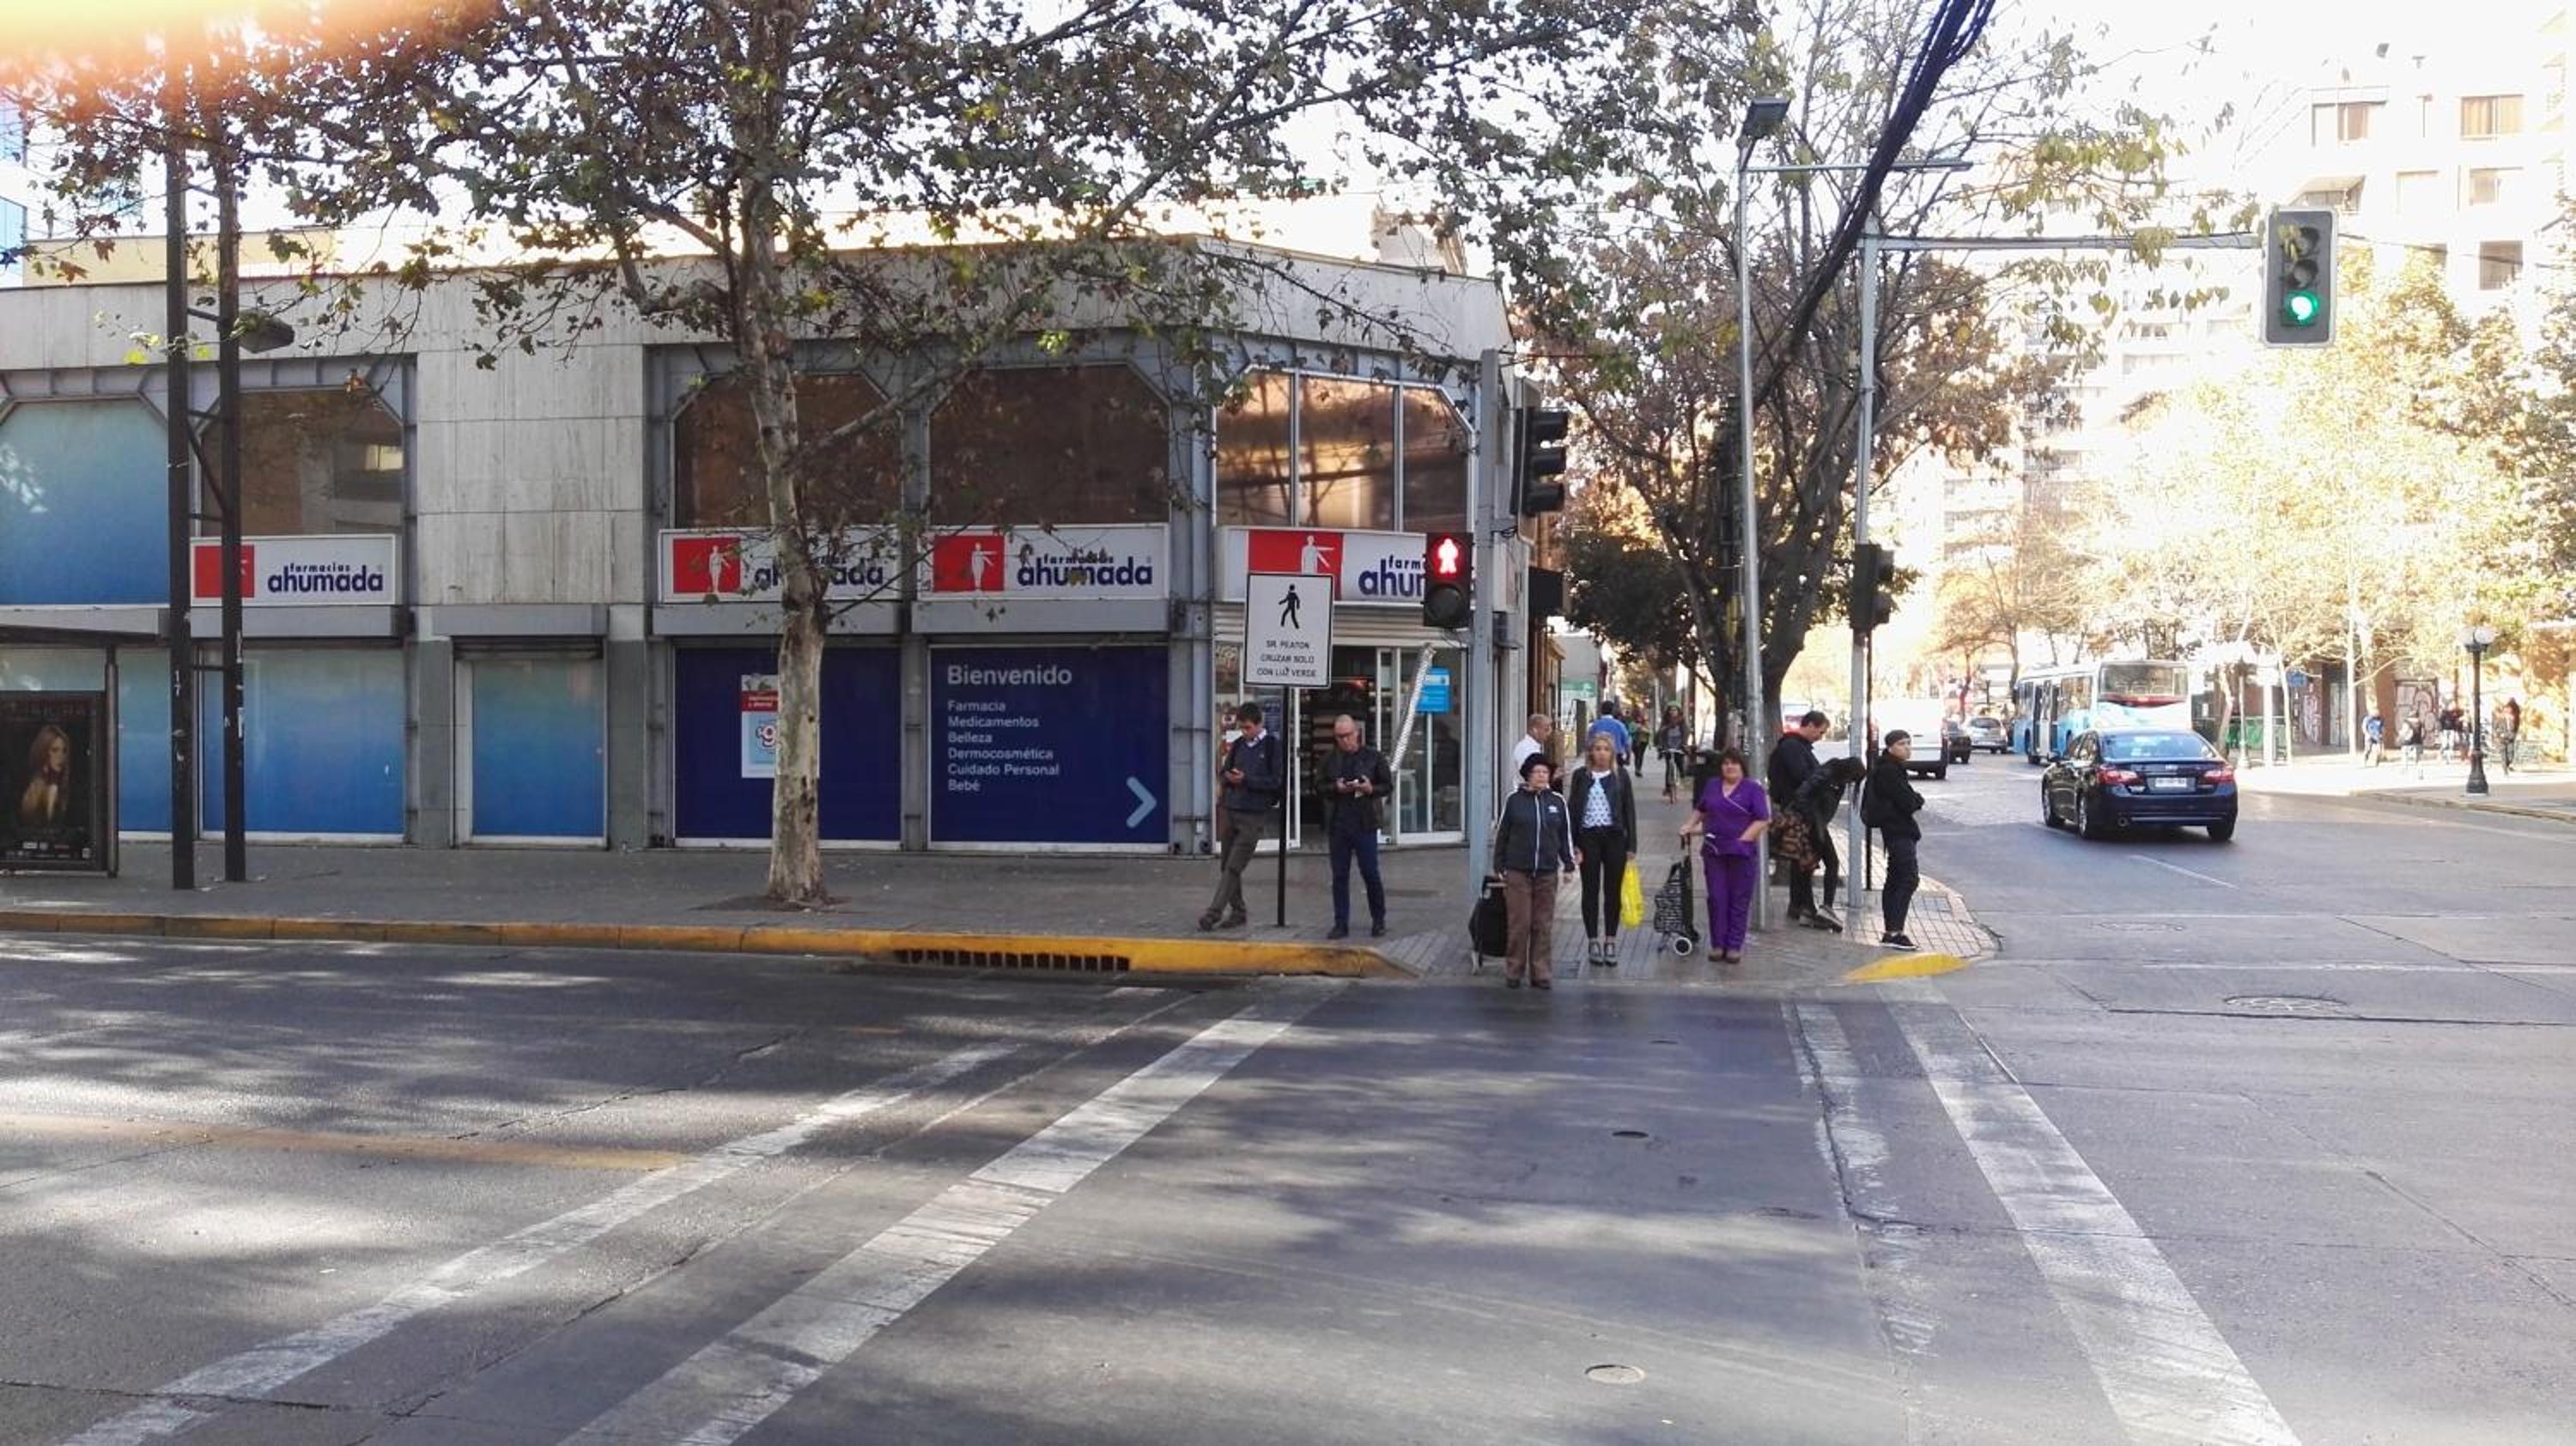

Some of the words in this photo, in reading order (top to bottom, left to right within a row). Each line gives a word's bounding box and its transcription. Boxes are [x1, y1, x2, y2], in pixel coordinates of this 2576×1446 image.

[289, 562, 350, 573] farmacias
[267, 564, 384, 592] ahumada
[1293, 655, 1315, 664] SOLO
[947, 664, 1072, 684] Bienvenido
[1256, 667, 1273, 677] CON
[1291, 669, 1317, 677] VERDE
[947, 700, 1006, 712] Farmacia
[947, 715, 1039, 727] Medicamentos
[947, 731, 993, 743] Belleza
[947, 746, 1054, 760] Dermocosmética
[947, 762, 1000, 775] Cuidado
[1004, 762, 1060, 775] Personal
[947, 778, 981, 791] Bebé
